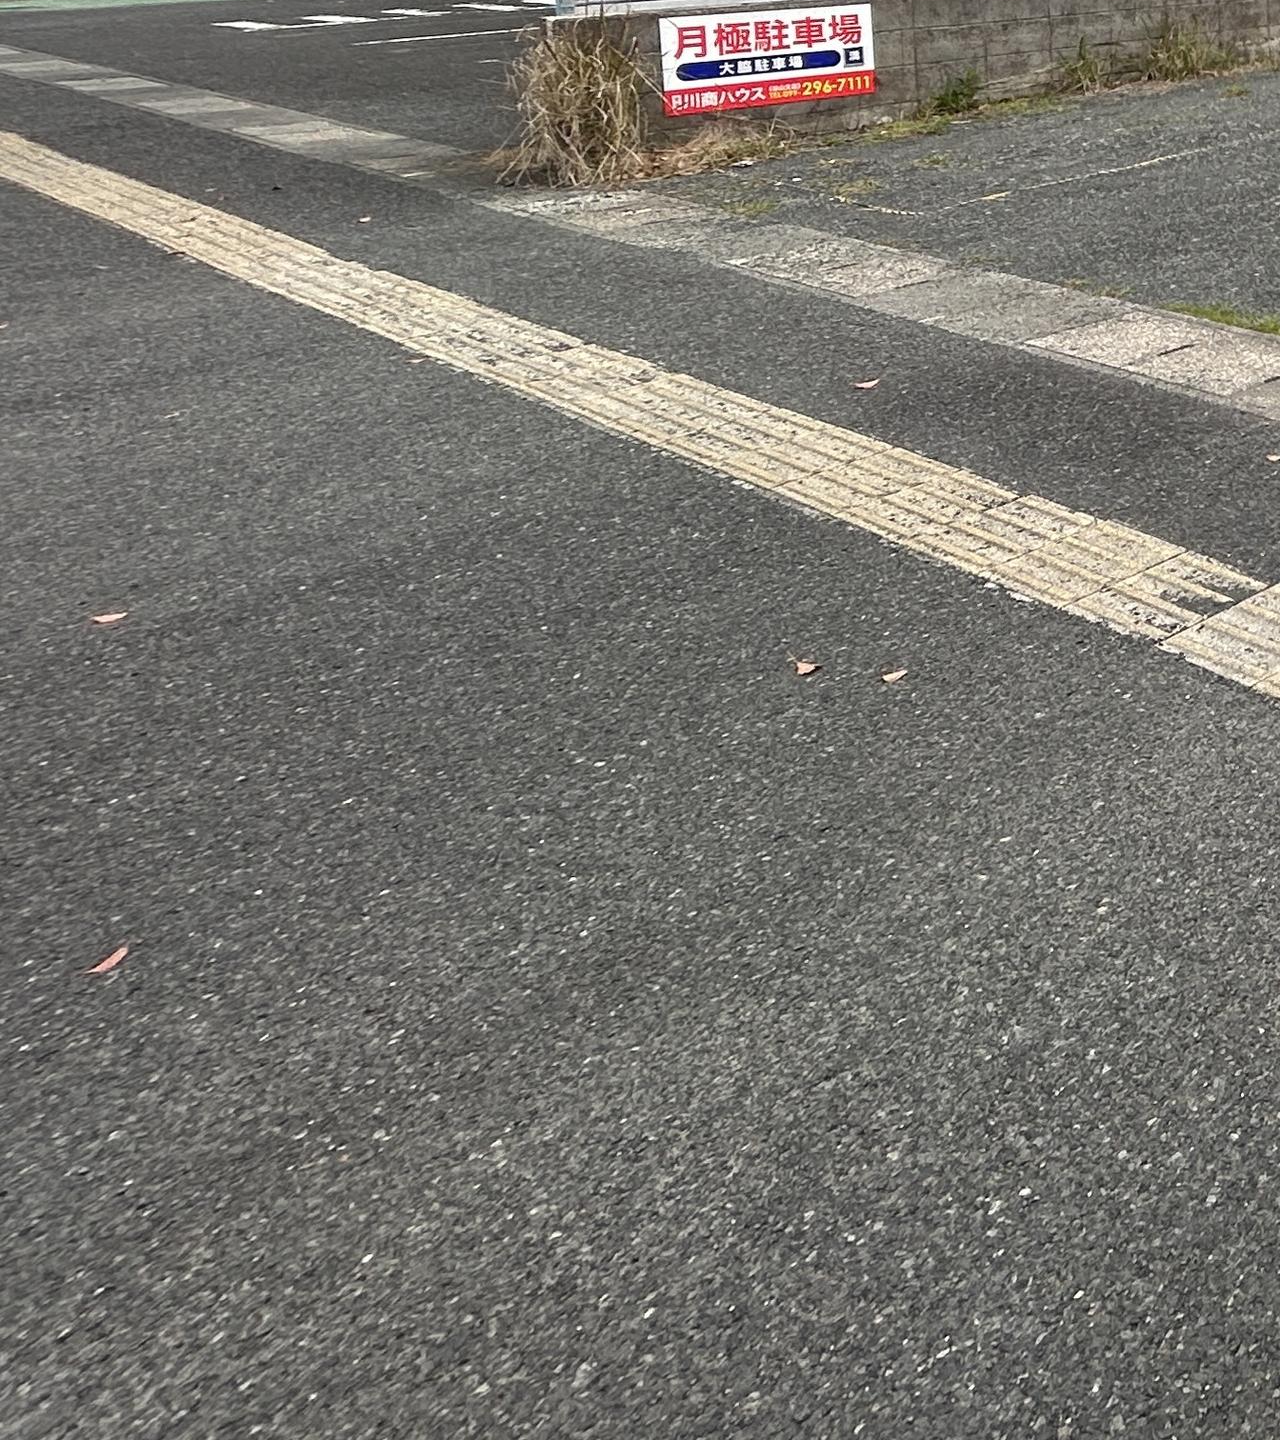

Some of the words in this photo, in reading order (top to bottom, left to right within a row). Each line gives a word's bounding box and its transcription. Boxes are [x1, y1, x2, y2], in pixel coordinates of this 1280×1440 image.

[673, 14, 863, 61] 月極駐車場
[802, 75, 870, 96] 296-7111
